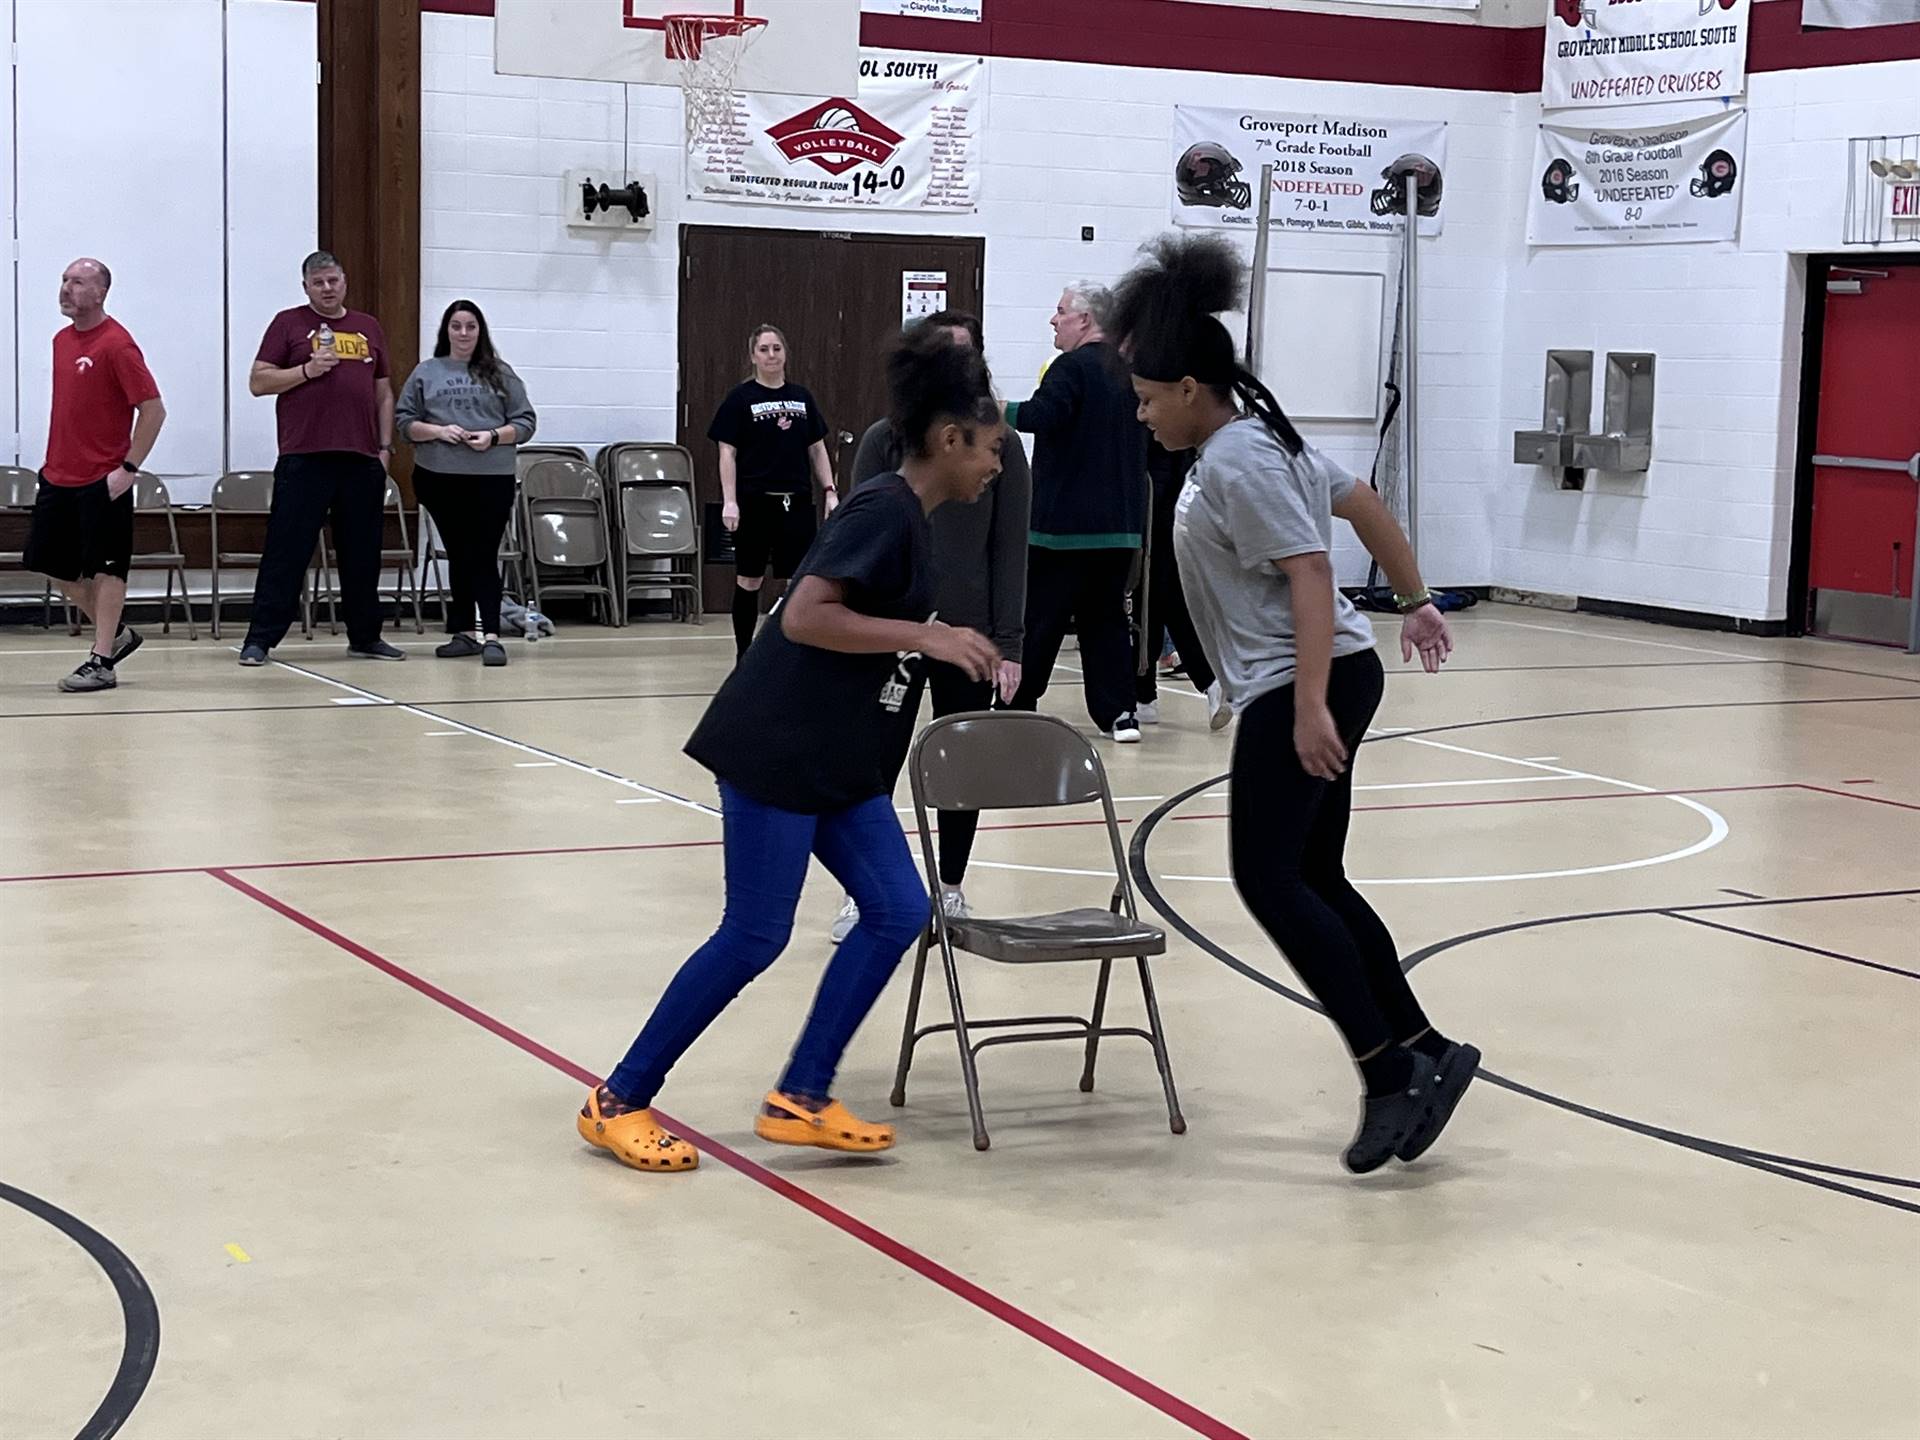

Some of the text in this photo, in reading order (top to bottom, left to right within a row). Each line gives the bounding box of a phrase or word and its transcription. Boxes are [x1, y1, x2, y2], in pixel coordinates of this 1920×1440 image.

[910, 2, 940, 12] Clayton
[942, 5, 978, 16] Saunders
[1558, 25, 1737, 58] GROVEPORT MIDDLE SCHOOL SOUTH
[884, 61, 938, 79] SOUTH
[1571, 70, 1722, 99] UNDEFEATED CRUISERS
[1239, 115, 1387, 138] Groveport Madison
[794, 138, 878, 156] VOLLEYBALL
[1276, 140, 1314, 154] Grade
[1320, 142, 1371, 157] Football
[1272, 160, 1352, 176] 2018 Season
[1600, 168, 1668, 183] 2016 Season
[730, 174, 848, 190] UNDEFEATED REGULAR SEASON
[852, 165, 905, 197] 14-0
[1272, 180, 1364, 196] NDEFEATED
[1294, 198, 1328, 212] 7-0-1
[1624, 207, 1642, 221] 8-0
